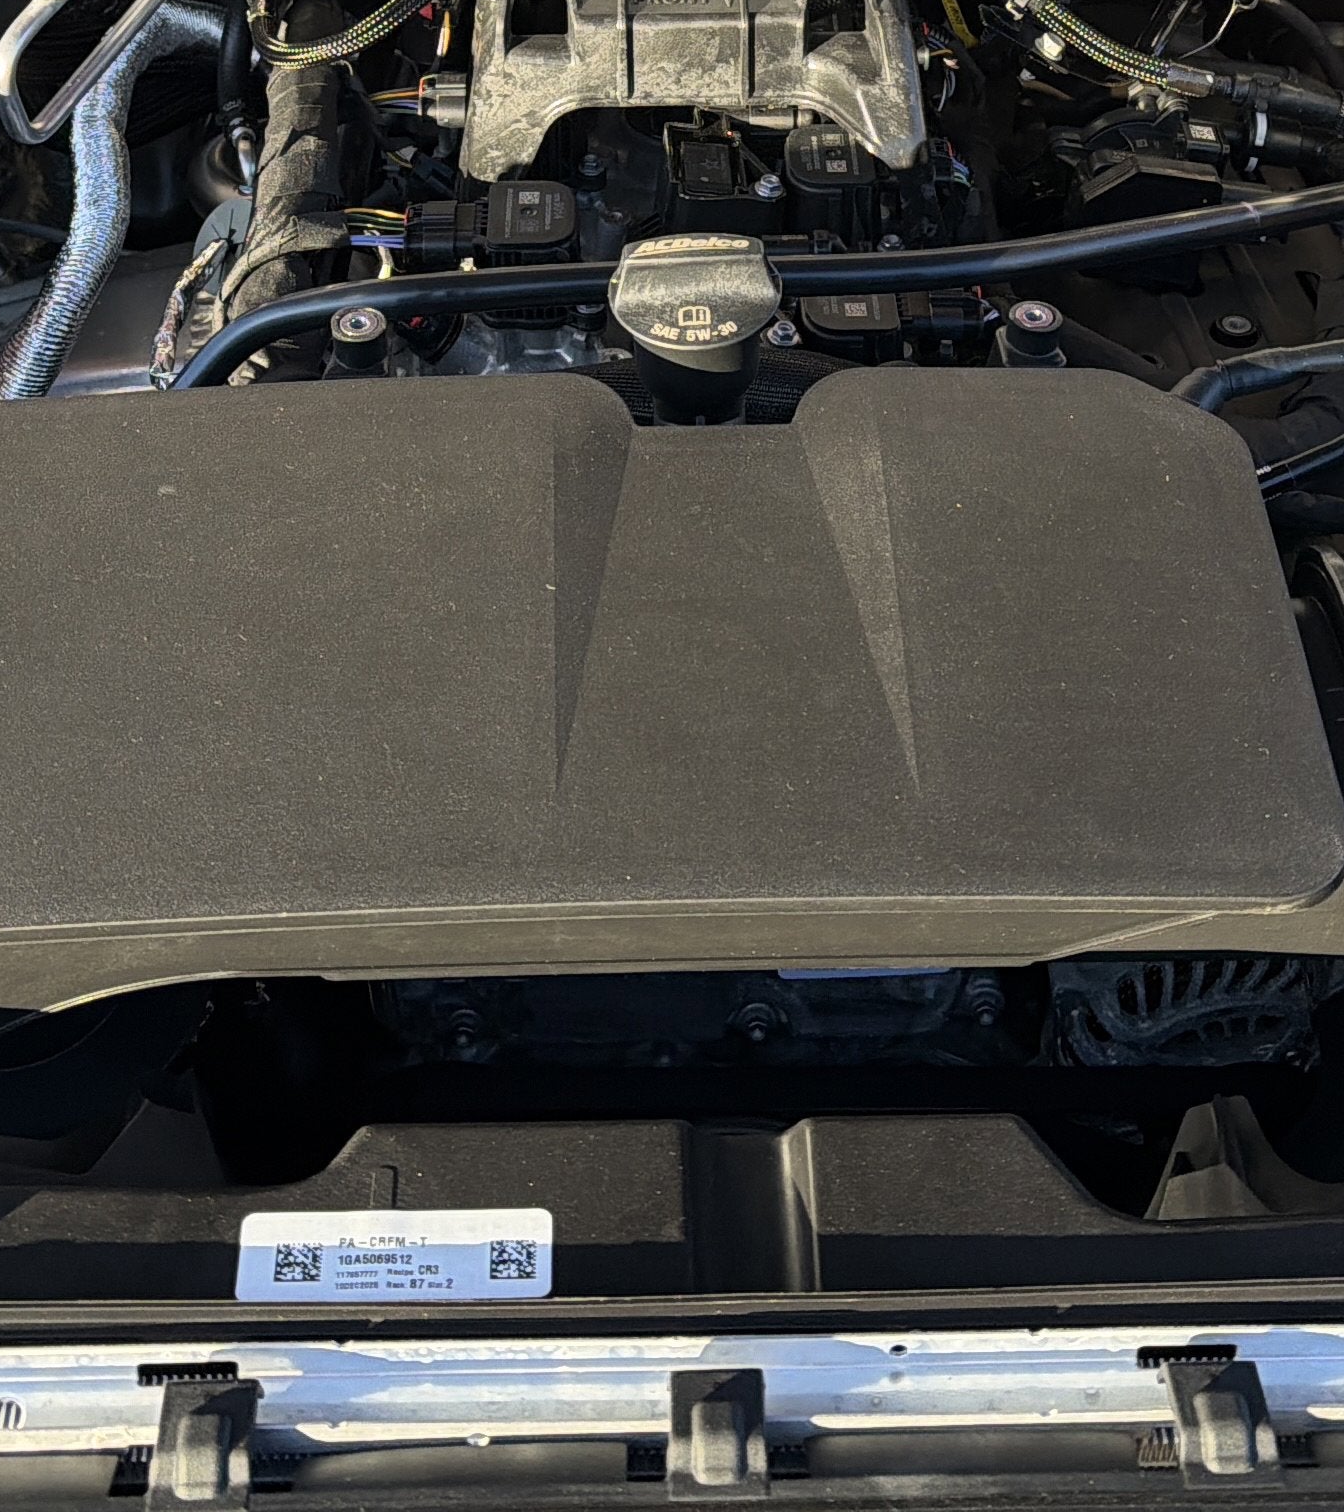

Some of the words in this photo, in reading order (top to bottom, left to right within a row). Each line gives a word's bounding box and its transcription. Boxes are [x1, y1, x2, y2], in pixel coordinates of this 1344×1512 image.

[634, 237, 750, 254] ACDelco
[650, 323, 680, 341] SAE
[685, 321, 738, 342] 5W-30
[337, 1254, 413, 1266] 1GA5069512
[418, 1264, 439, 1275] CR3
[409, 1278, 425, 1289] 87
[445, 1277, 454, 1289] 2
